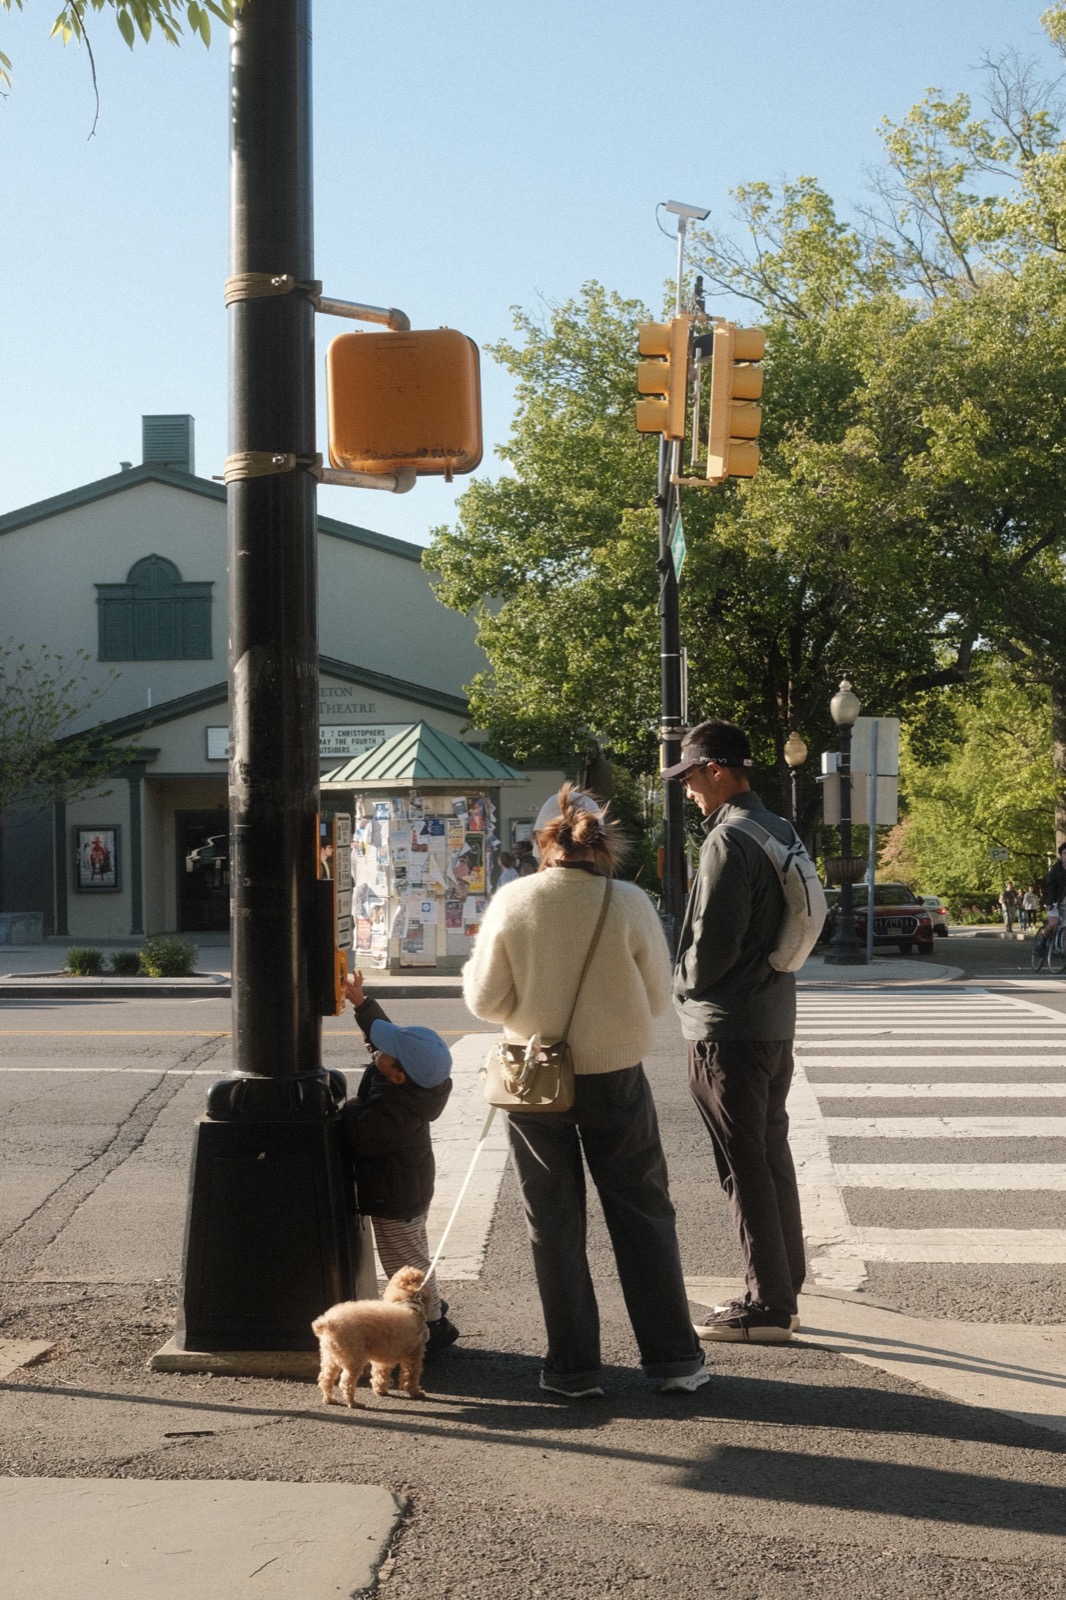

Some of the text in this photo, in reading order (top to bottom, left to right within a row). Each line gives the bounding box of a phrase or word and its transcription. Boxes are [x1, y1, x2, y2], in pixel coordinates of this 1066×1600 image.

[320, 687, 353, 697] ETON
[319, 702, 376, 714] THEATRE
[338, 729, 386, 737] CHRISTOPHERS
[319, 738, 331, 746] MAY
[319, 746, 351, 754] UTSIDERS
[992, 850, 999, 859] P
